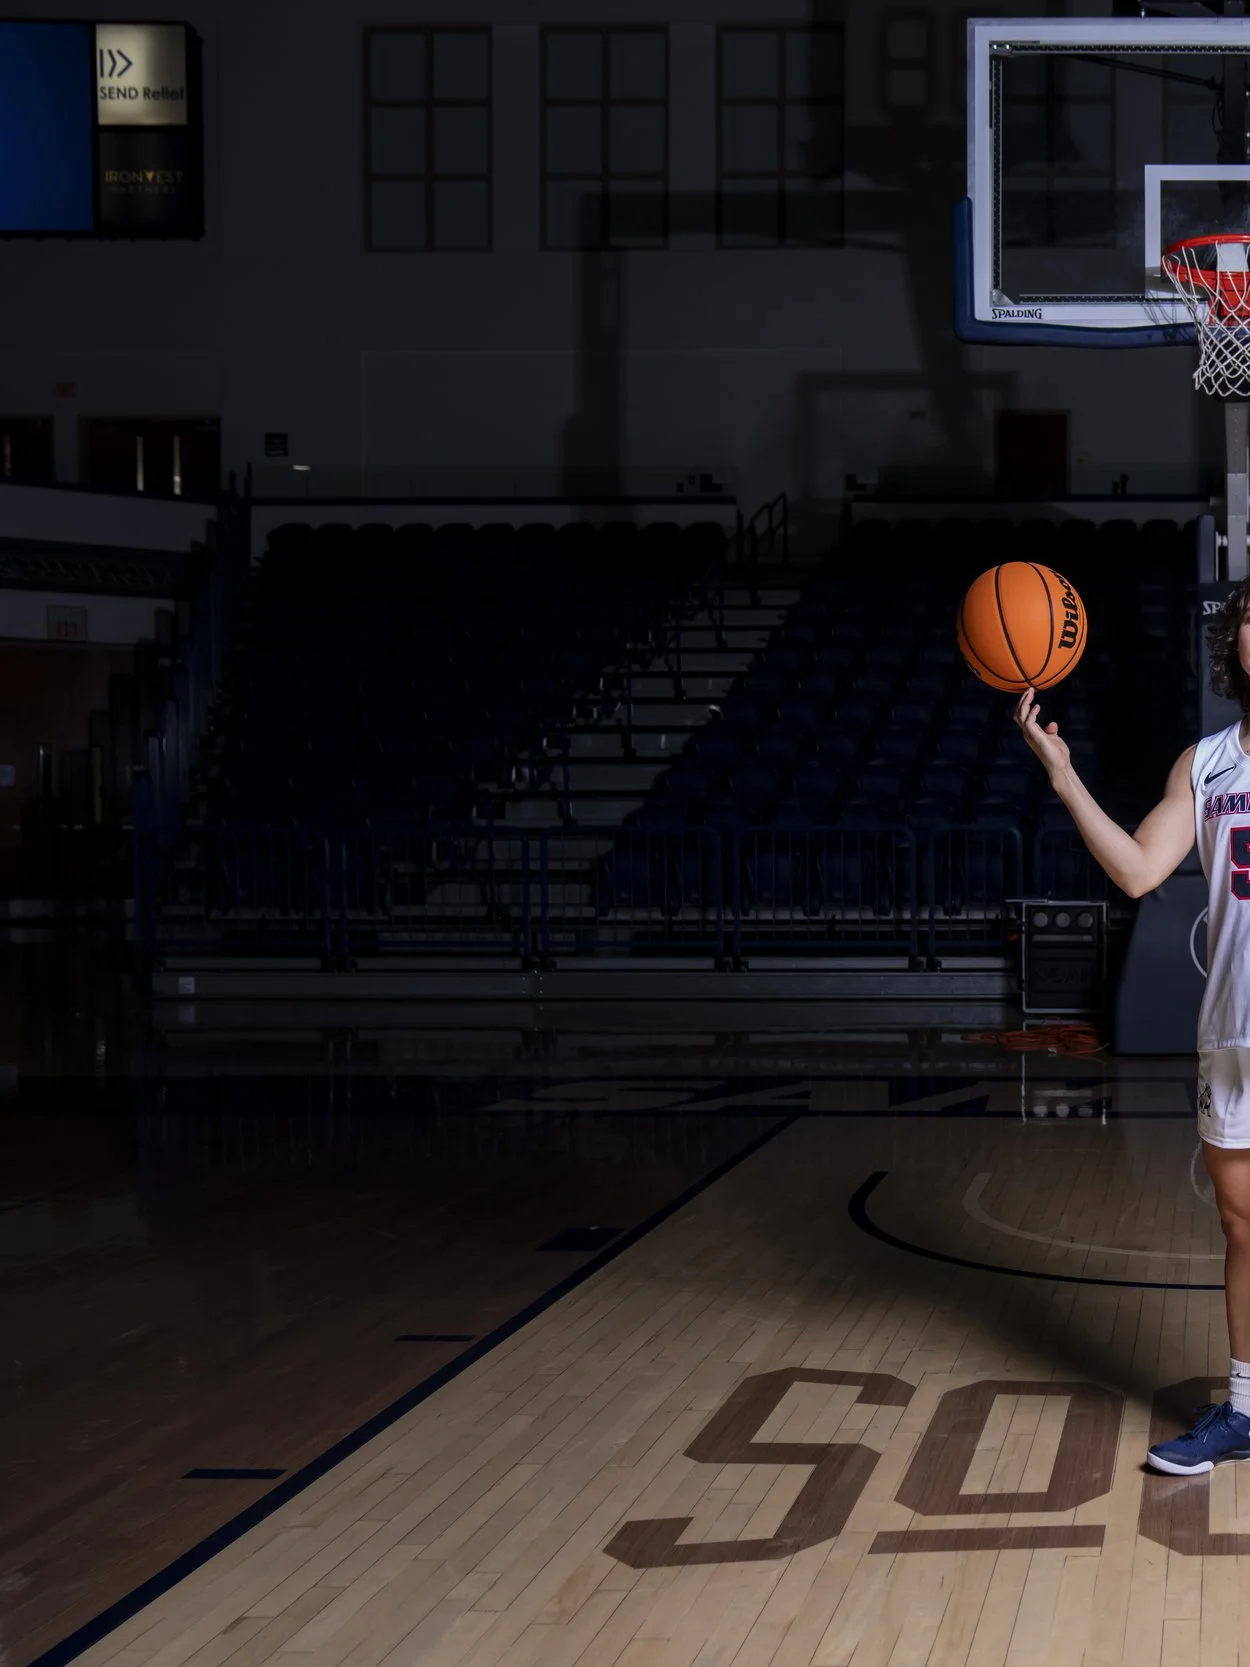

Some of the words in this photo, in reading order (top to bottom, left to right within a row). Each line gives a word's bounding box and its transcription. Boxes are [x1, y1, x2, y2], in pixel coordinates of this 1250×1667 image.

[100, 86, 139, 100] SEND
[143, 86, 185, 100] Relief
[991, 307, 1042, 320] SPALDING
